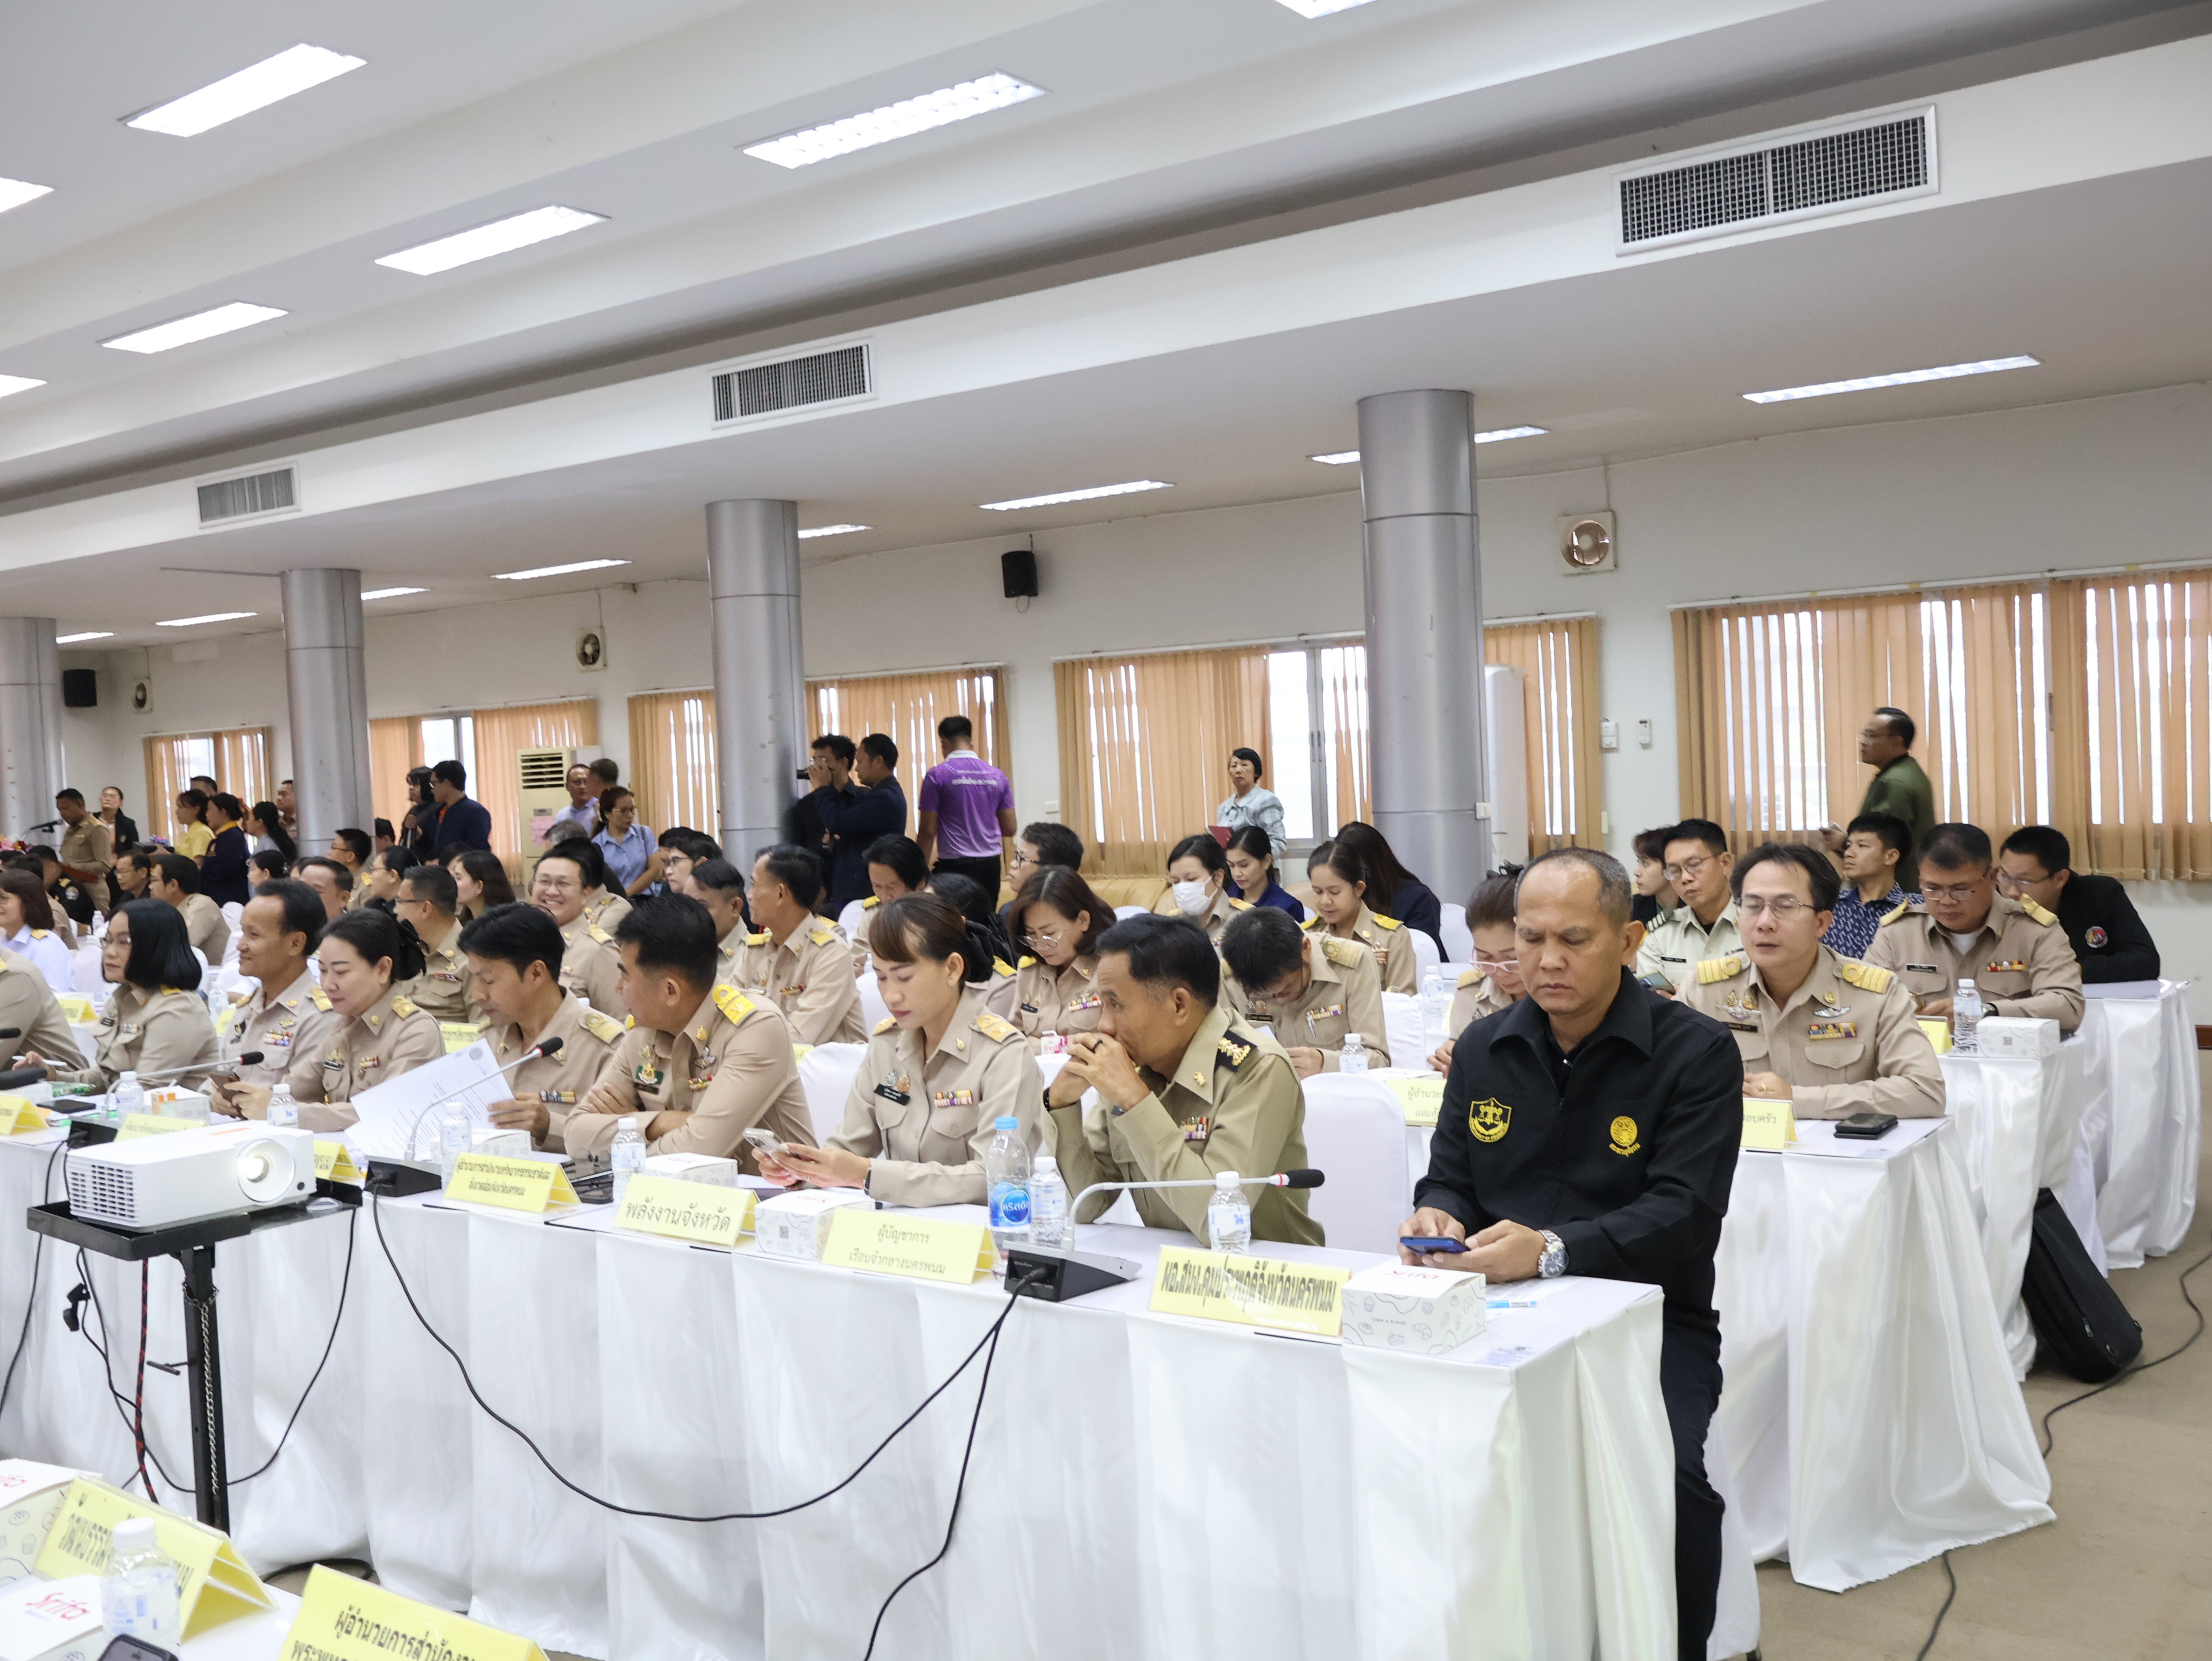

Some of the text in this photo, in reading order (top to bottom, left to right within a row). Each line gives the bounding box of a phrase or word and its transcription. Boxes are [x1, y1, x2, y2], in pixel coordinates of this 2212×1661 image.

[1408, 1086, 1442, 1101] ผู้อำนวย
[1742, 1112, 1777, 1124] รอบครัว
[625, 1196, 731, 1232] พลังงานจังหวัด
[877, 1223, 931, 1244] ผู้บัญชาการ
[849, 1247, 946, 1274] เรือนจำกลางนครพนม
[335, 1604, 477, 1661] ผู้อำนวยการสำนัก
